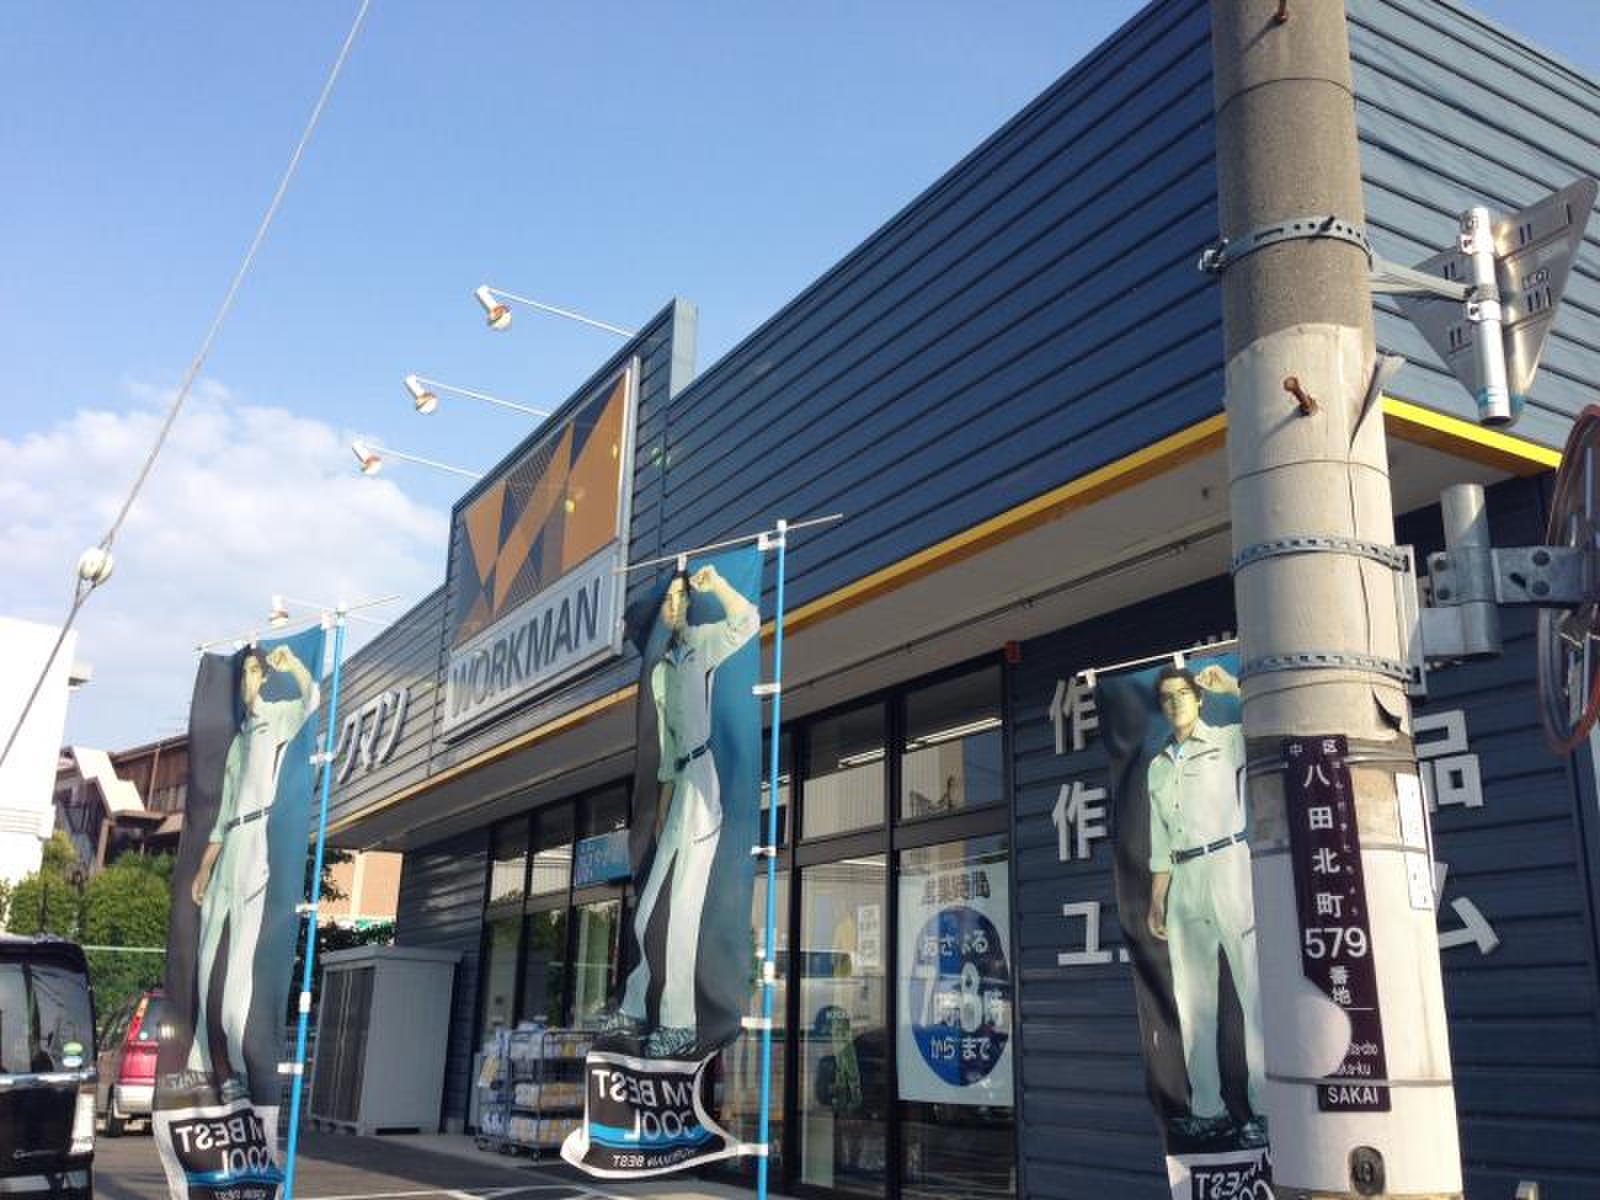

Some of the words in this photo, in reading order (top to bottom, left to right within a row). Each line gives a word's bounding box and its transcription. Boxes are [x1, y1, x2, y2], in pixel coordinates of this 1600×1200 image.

[453, 576, 600, 719] WORKMAN
[1303, 763, 1345, 919] 八田北町
[1304, 927, 1368, 959] 579
[929, 1036, 957, 1061] から
[961, 1036, 992, 1061] まで
[1327, 1087, 1378, 1105] SAKAI
